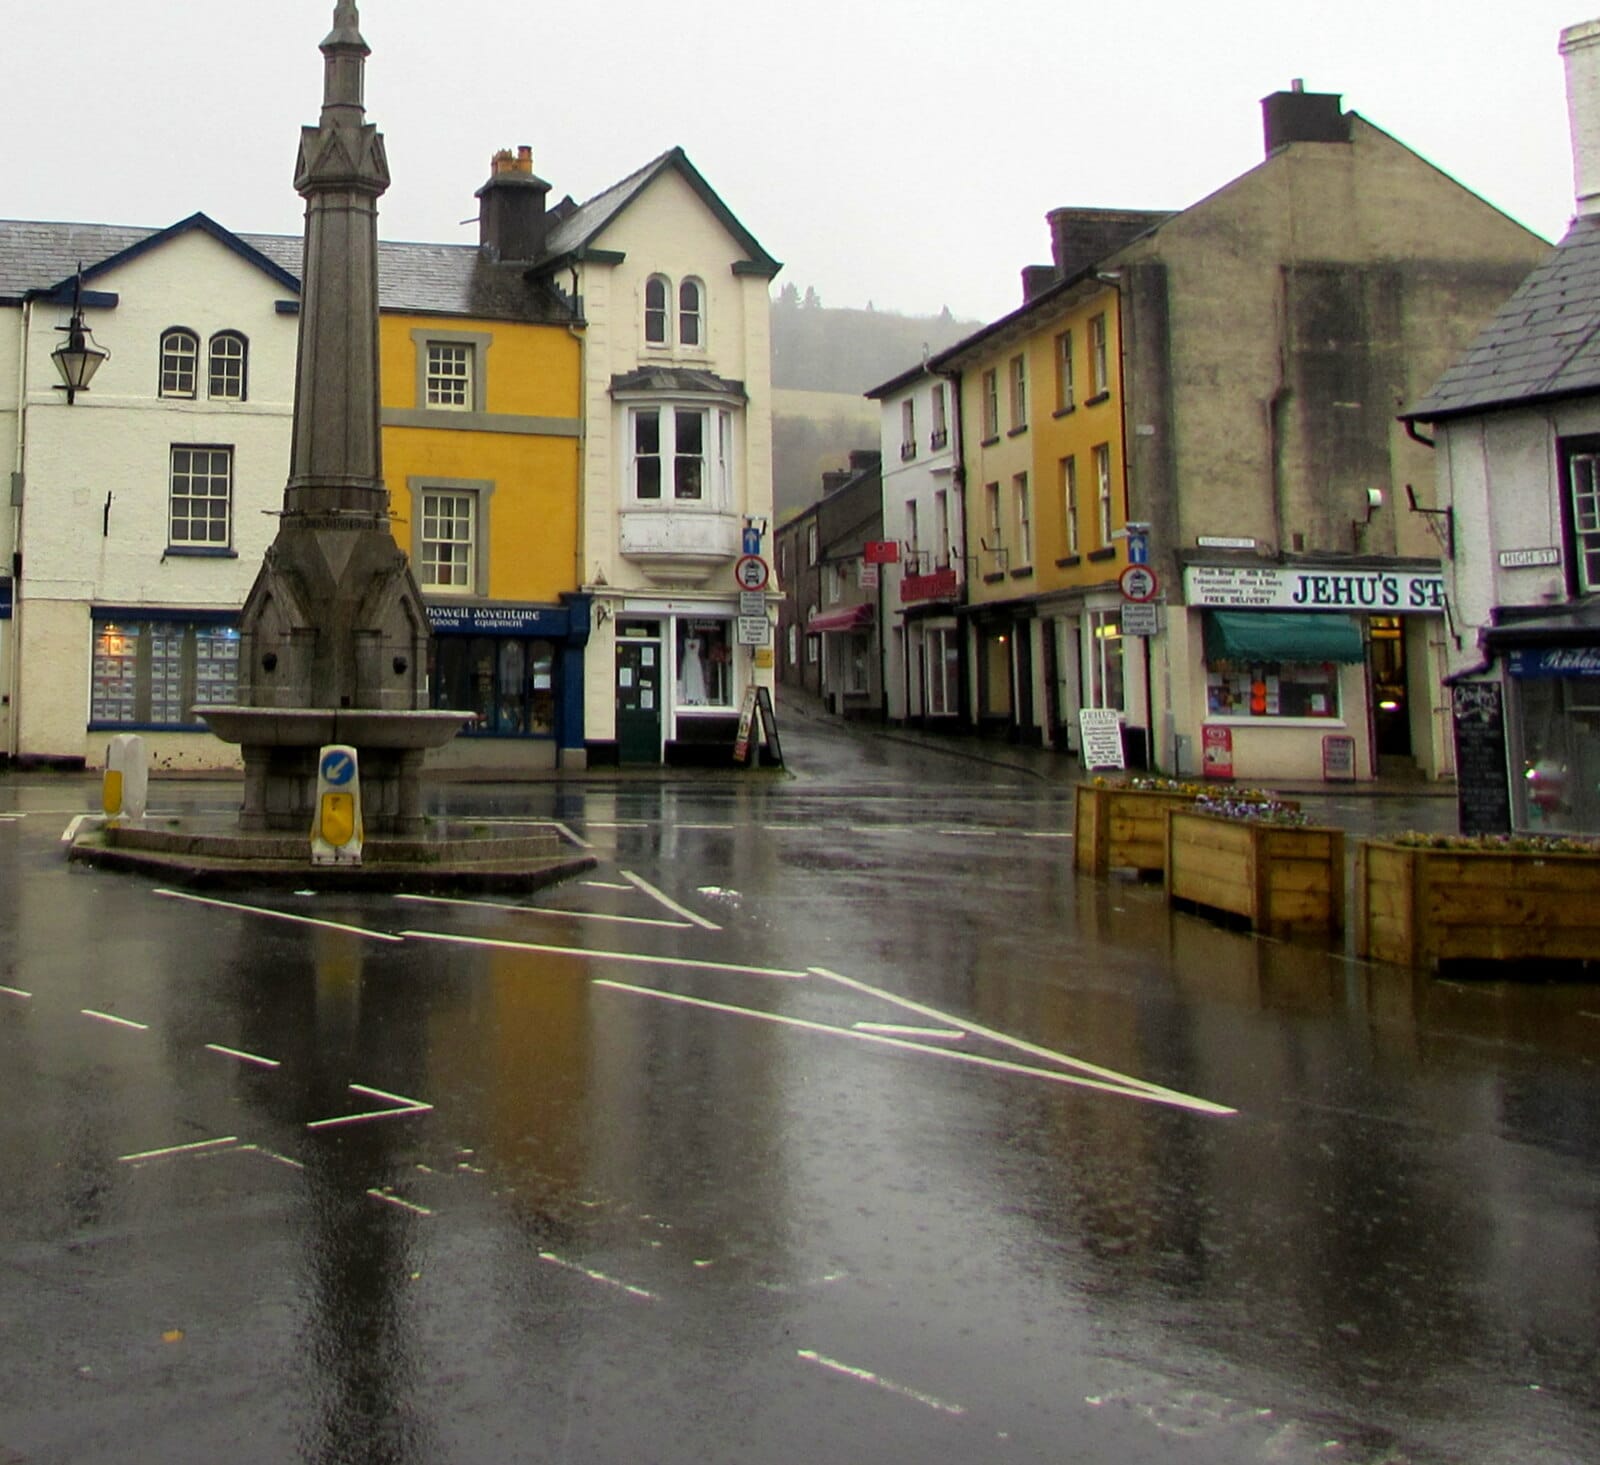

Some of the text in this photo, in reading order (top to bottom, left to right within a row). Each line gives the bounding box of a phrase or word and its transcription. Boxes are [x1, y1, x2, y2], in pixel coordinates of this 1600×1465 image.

[1503, 551, 1551, 565] HIGH ST
[1292, 572, 1399, 605] JEHU'S
[1230, 596, 1271, 604] DELIVERY
